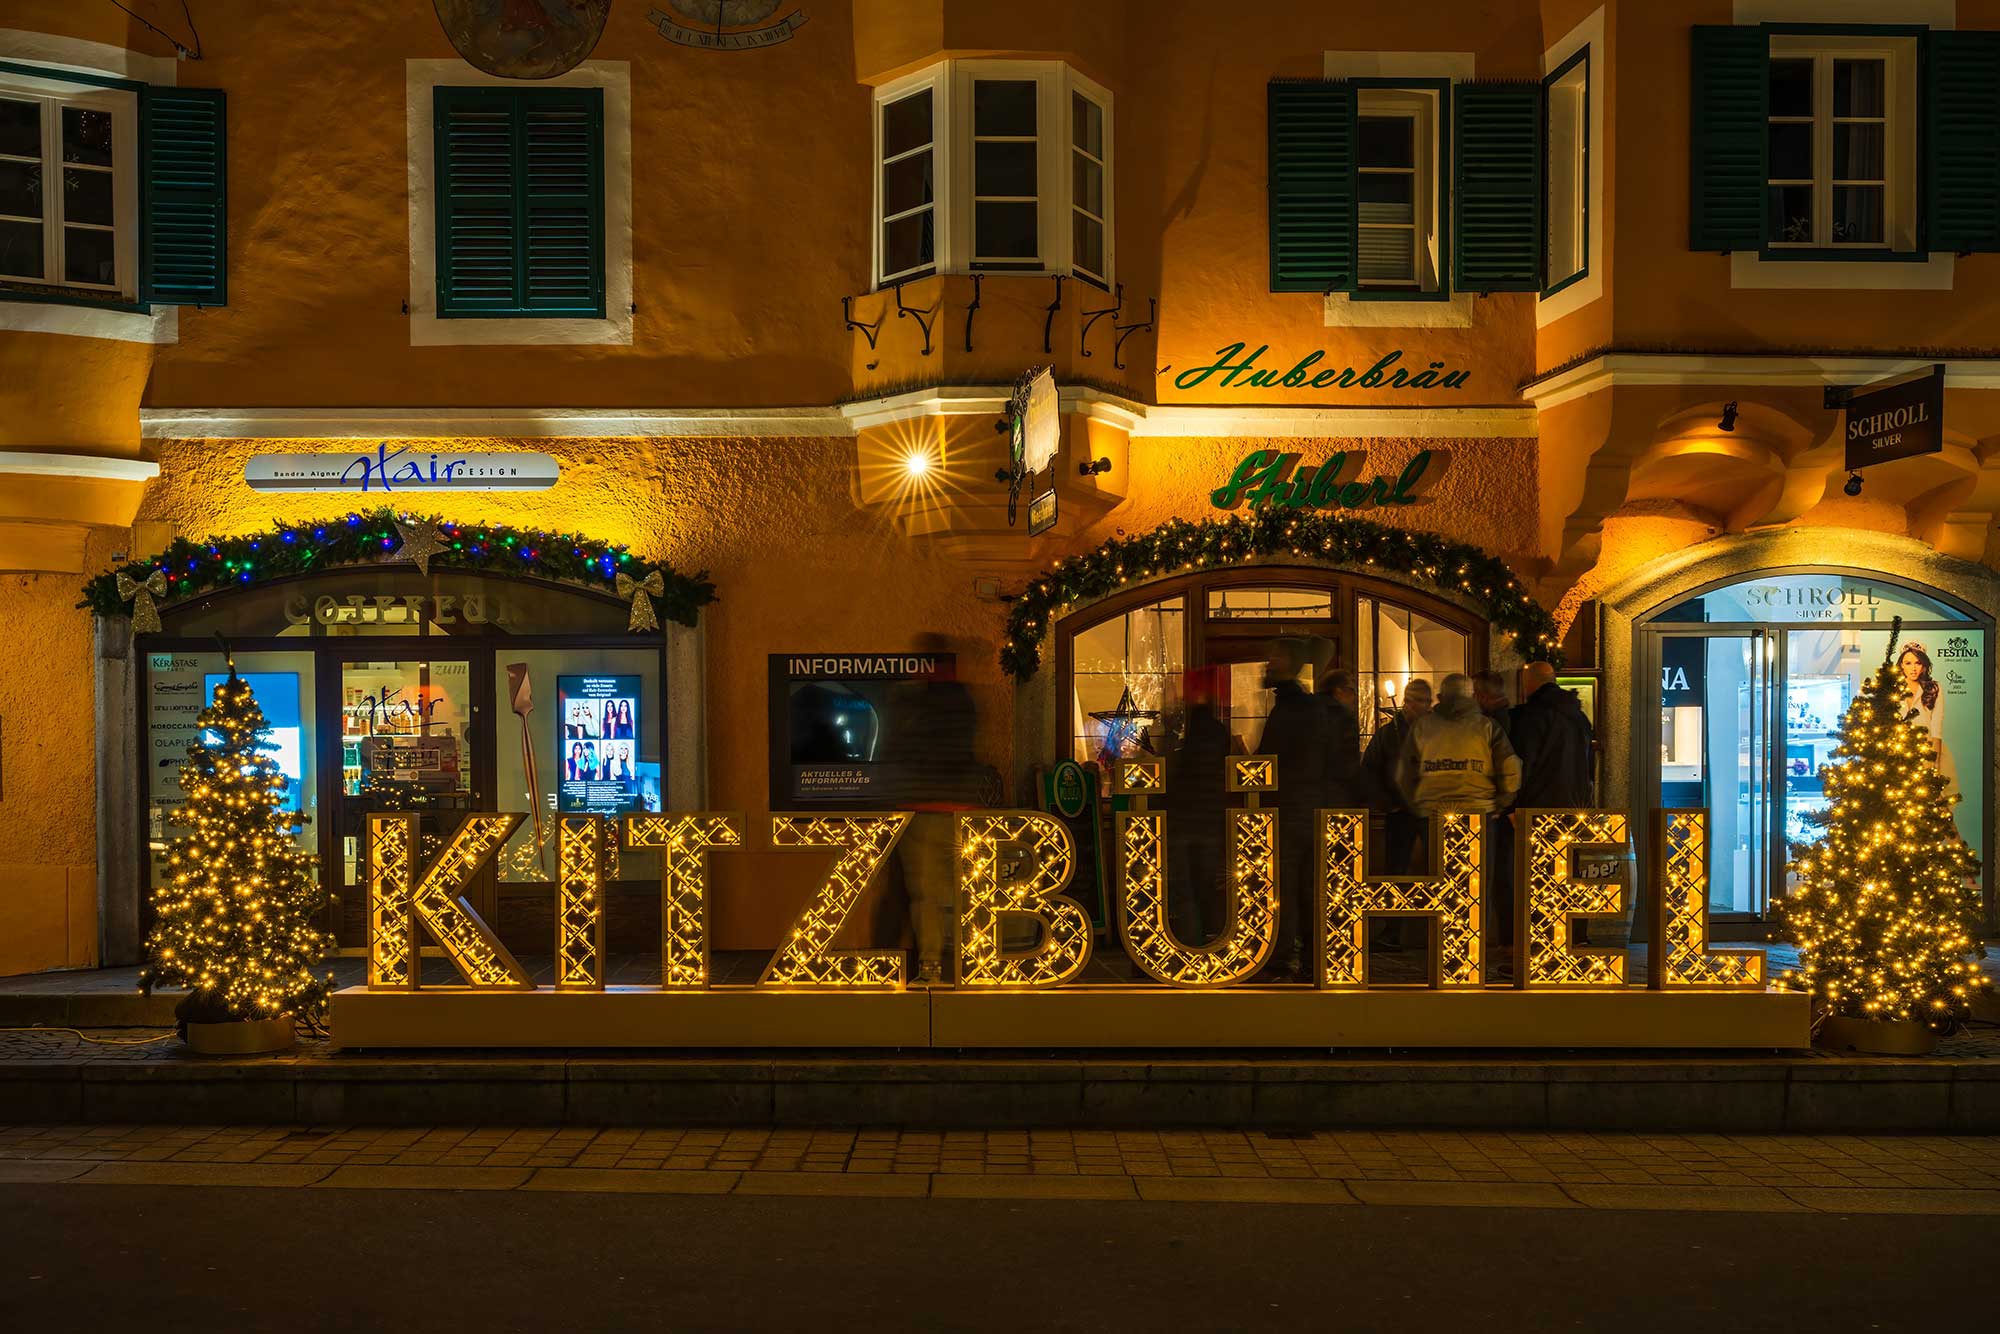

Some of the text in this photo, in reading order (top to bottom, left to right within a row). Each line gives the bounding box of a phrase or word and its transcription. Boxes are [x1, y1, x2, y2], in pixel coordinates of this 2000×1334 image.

[1174, 342, 1471, 389] Huberbräu
[1848, 402, 1929, 440] SCHROLL
[1872, 433, 1902, 449] SILVER
[310, 470, 341, 478] Aigner
[340, 442, 466, 491] Hair
[457, 467, 517, 476] DESIGN
[1747, 587, 1880, 605] SCHROLL
[152, 656, 198, 668] KÉRASTASE
[1937, 648, 1979, 658] FESTINA
[788, 657, 935, 675] INFORMATION
[354, 686, 448, 738] Hair
[154, 738, 191, 747] OLAPLE
[800, 769, 853, 778] AKTUELLES
[801, 776, 871, 785] INFORMATIVES
[366, 755, 1767, 991] KITZBÜHEL
